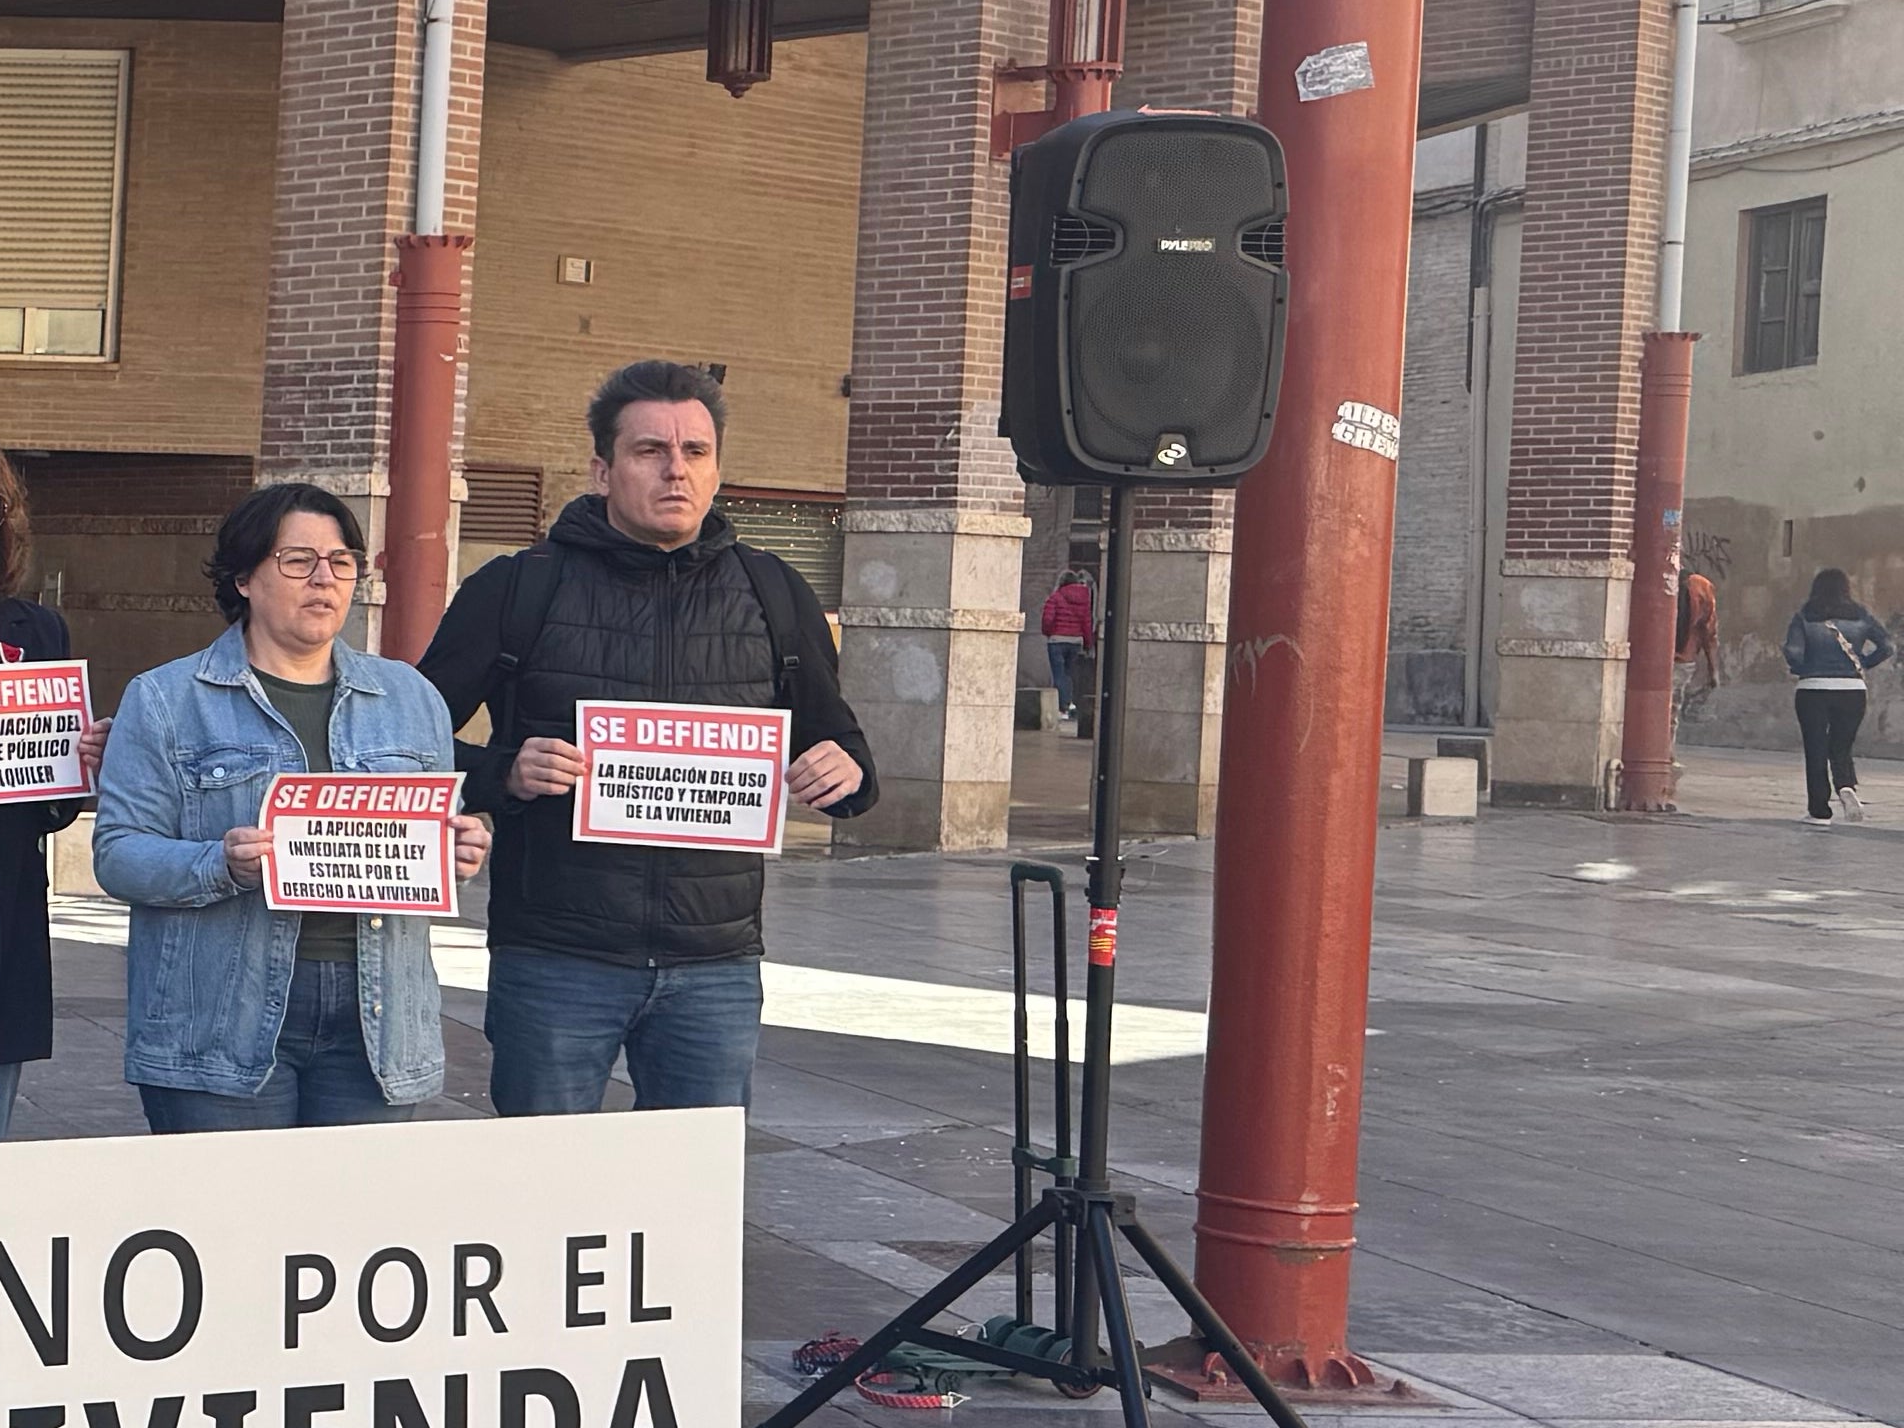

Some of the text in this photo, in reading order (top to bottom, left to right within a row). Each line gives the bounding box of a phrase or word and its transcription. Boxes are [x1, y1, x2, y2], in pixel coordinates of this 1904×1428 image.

[57, 715, 81, 732] DEL
[590, 716, 777, 753] SE DEFIENDE
[274, 785, 449, 812] SE DEFIENDE
[284, 1243, 509, 1350] POR
[565, 1232, 672, 1329] EL
